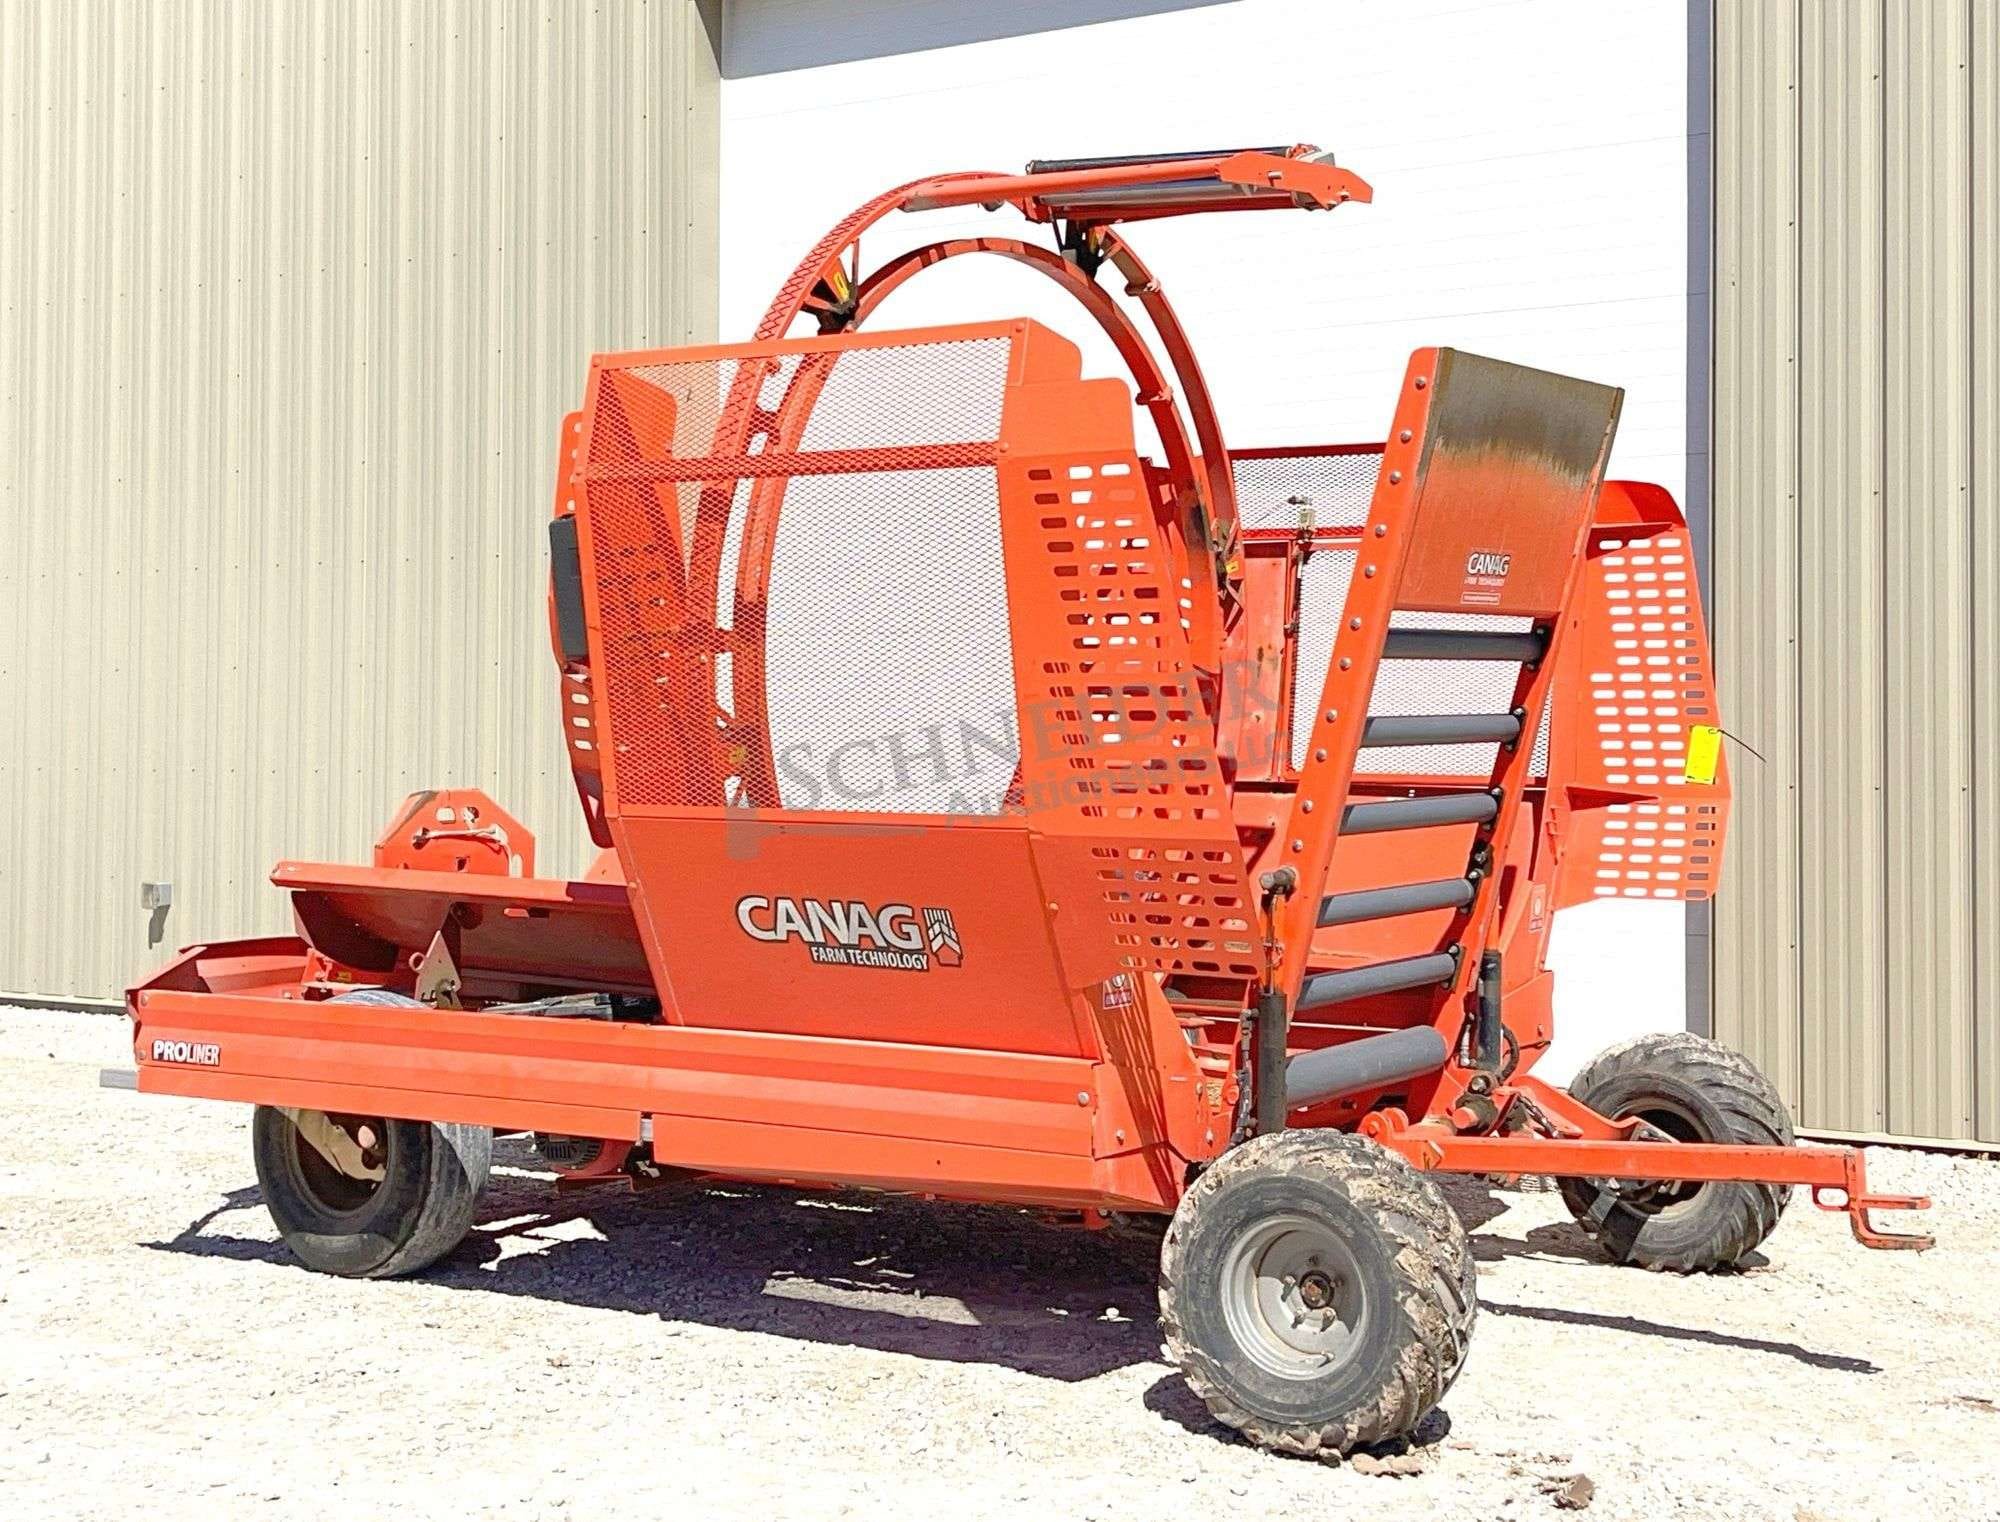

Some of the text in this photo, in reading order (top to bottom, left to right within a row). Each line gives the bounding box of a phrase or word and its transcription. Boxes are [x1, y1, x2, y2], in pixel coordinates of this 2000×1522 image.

[1467, 552, 1511, 576] CANAG
[737, 895, 924, 951] CANAG
[812, 947, 929, 970] FARM TECHNOLOGY
[153, 1039, 220, 1066] PROLINER
